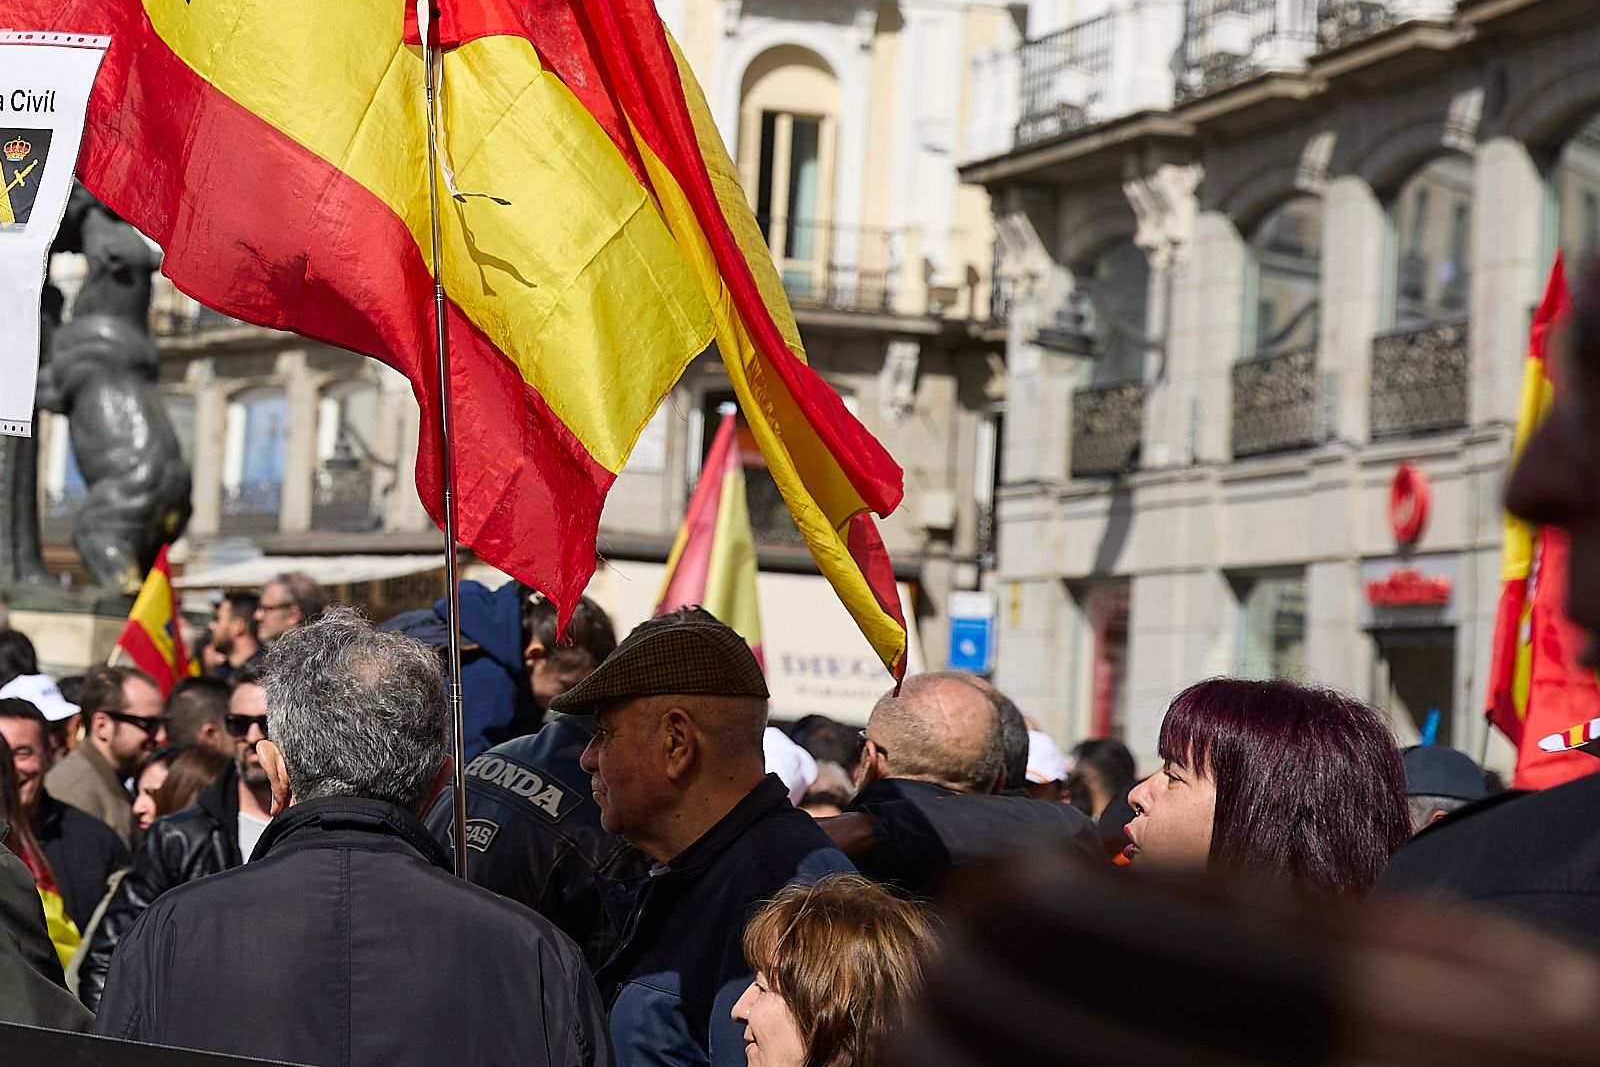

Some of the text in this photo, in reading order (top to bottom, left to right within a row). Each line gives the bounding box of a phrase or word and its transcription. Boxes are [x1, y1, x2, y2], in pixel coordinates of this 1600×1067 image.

[10, 89, 55, 113] Civil
[782, 653, 882, 680] DIEG
[464, 755, 564, 818] HONDA
